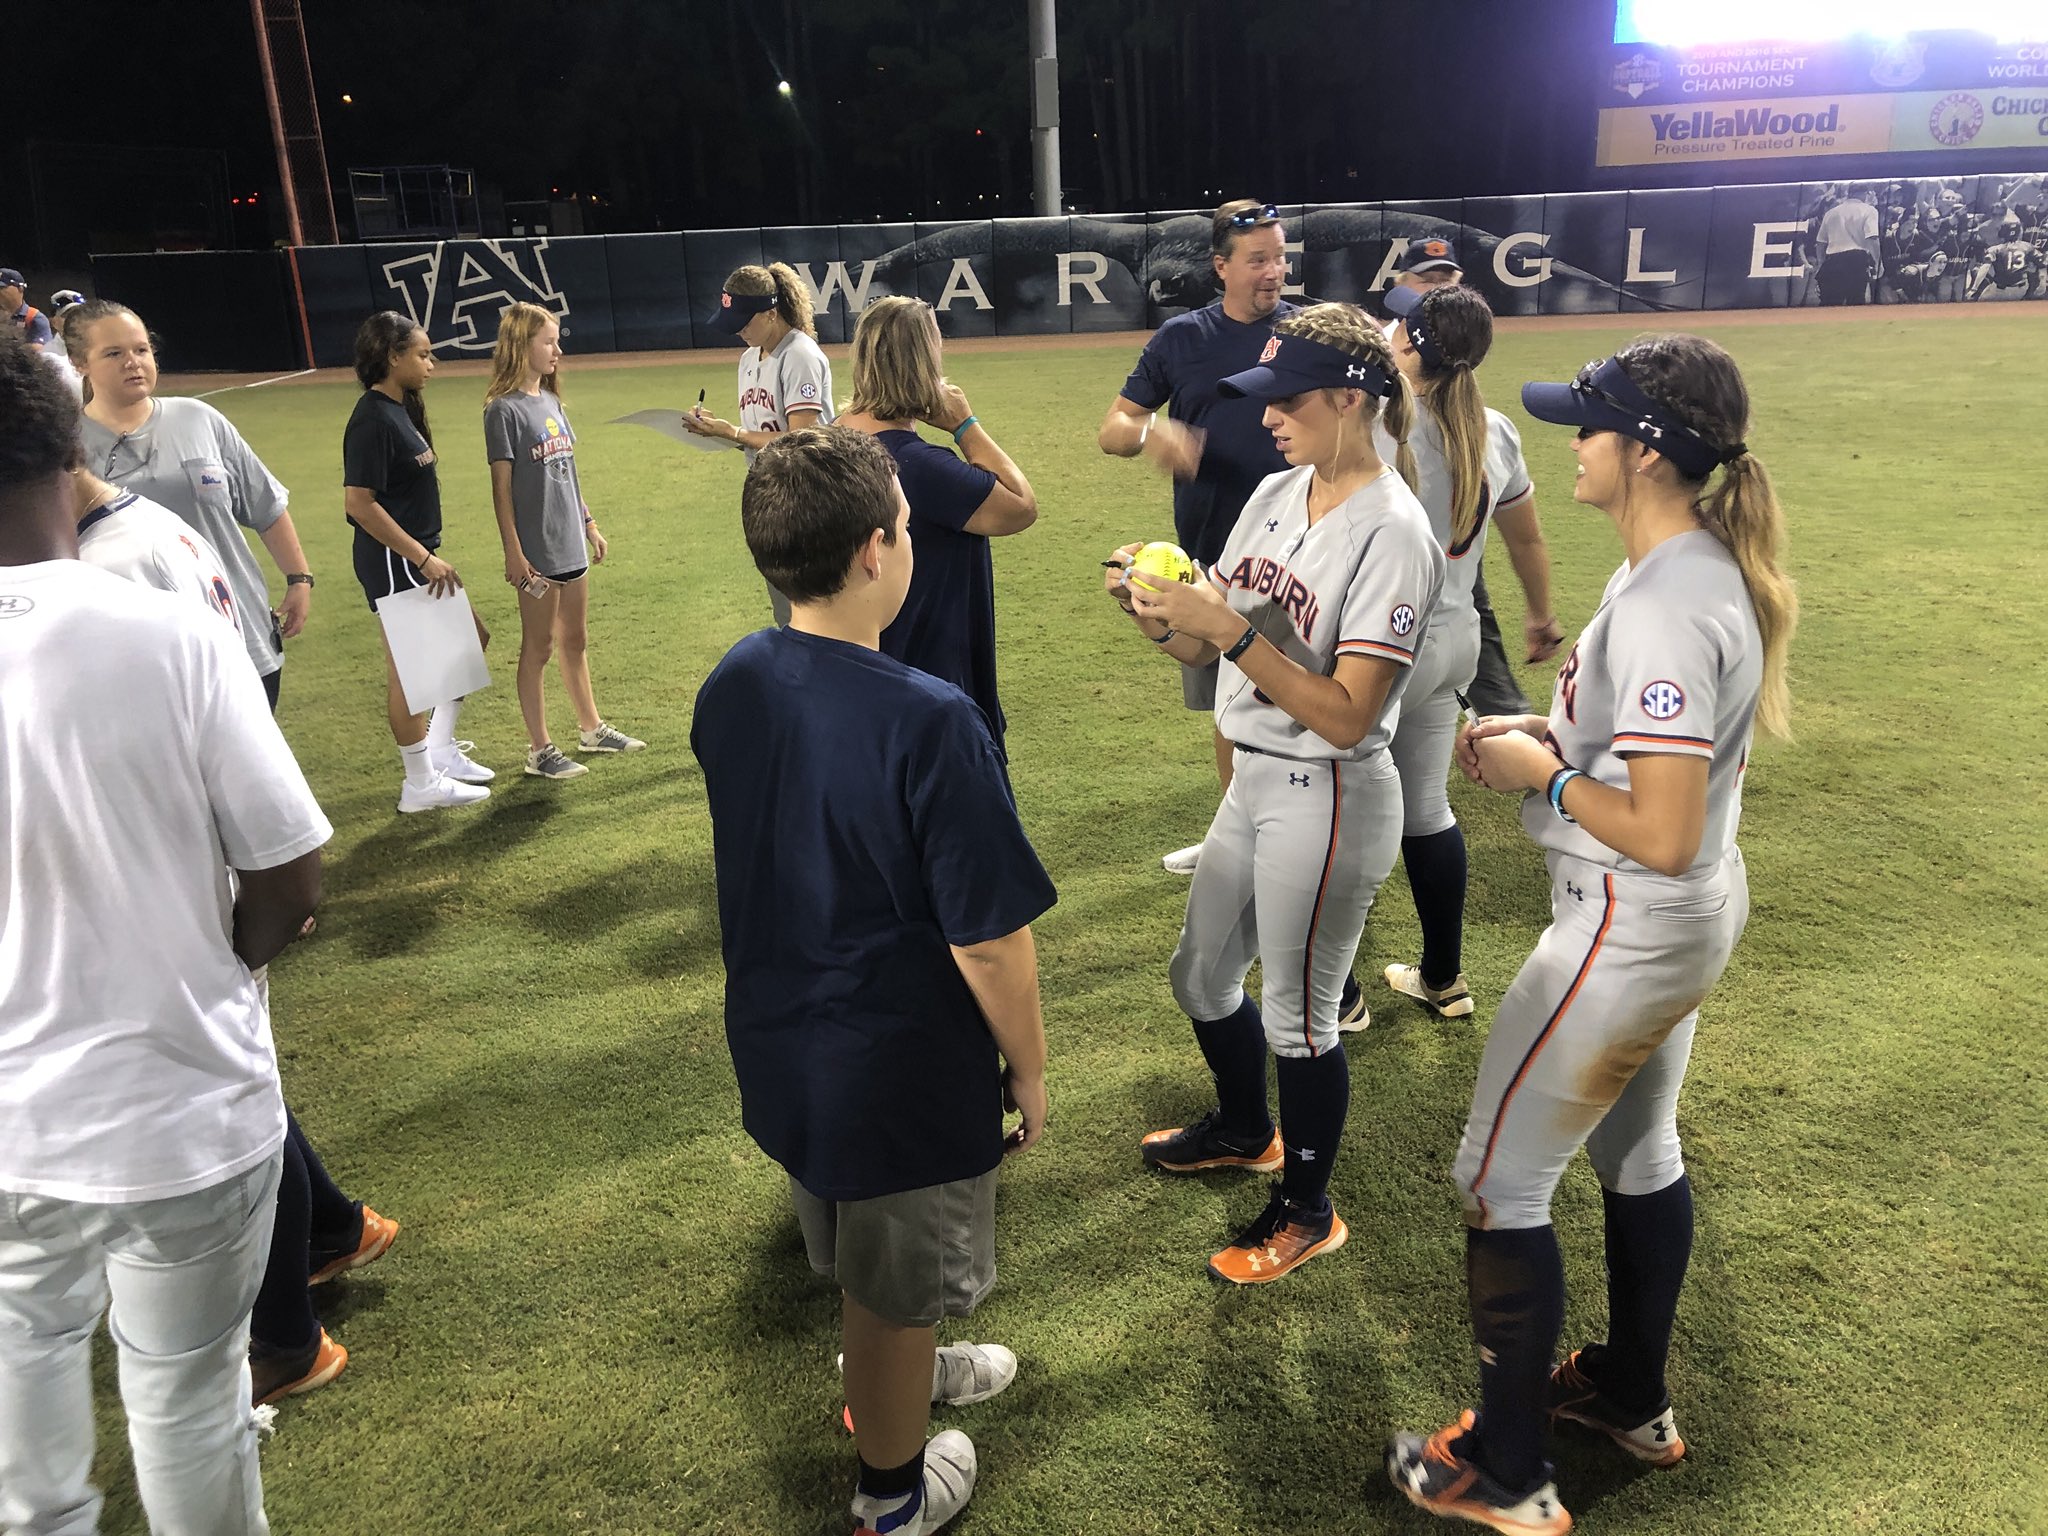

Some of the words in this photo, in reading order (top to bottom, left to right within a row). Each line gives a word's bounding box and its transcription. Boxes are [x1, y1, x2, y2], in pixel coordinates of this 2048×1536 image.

[1676, 57, 1808, 77] TOURNAMENT
[1682, 74, 1795, 93] CHAMPIONS
[1650, 104, 1839, 141] YellaWood
[1654, 140, 1726, 155] Pressure
[1732, 137, 1793, 151] Treated
[1800, 135, 1835, 148] Pine
[2007, 251, 2025, 270] 13
[795, 251, 1111, 315] WAR
[801, 384, 816, 398] SEC
[1228, 556, 1320, 645] AUBURN
[1392, 605, 1415, 636] SEC
[1642, 682, 1684, 718] SEC
